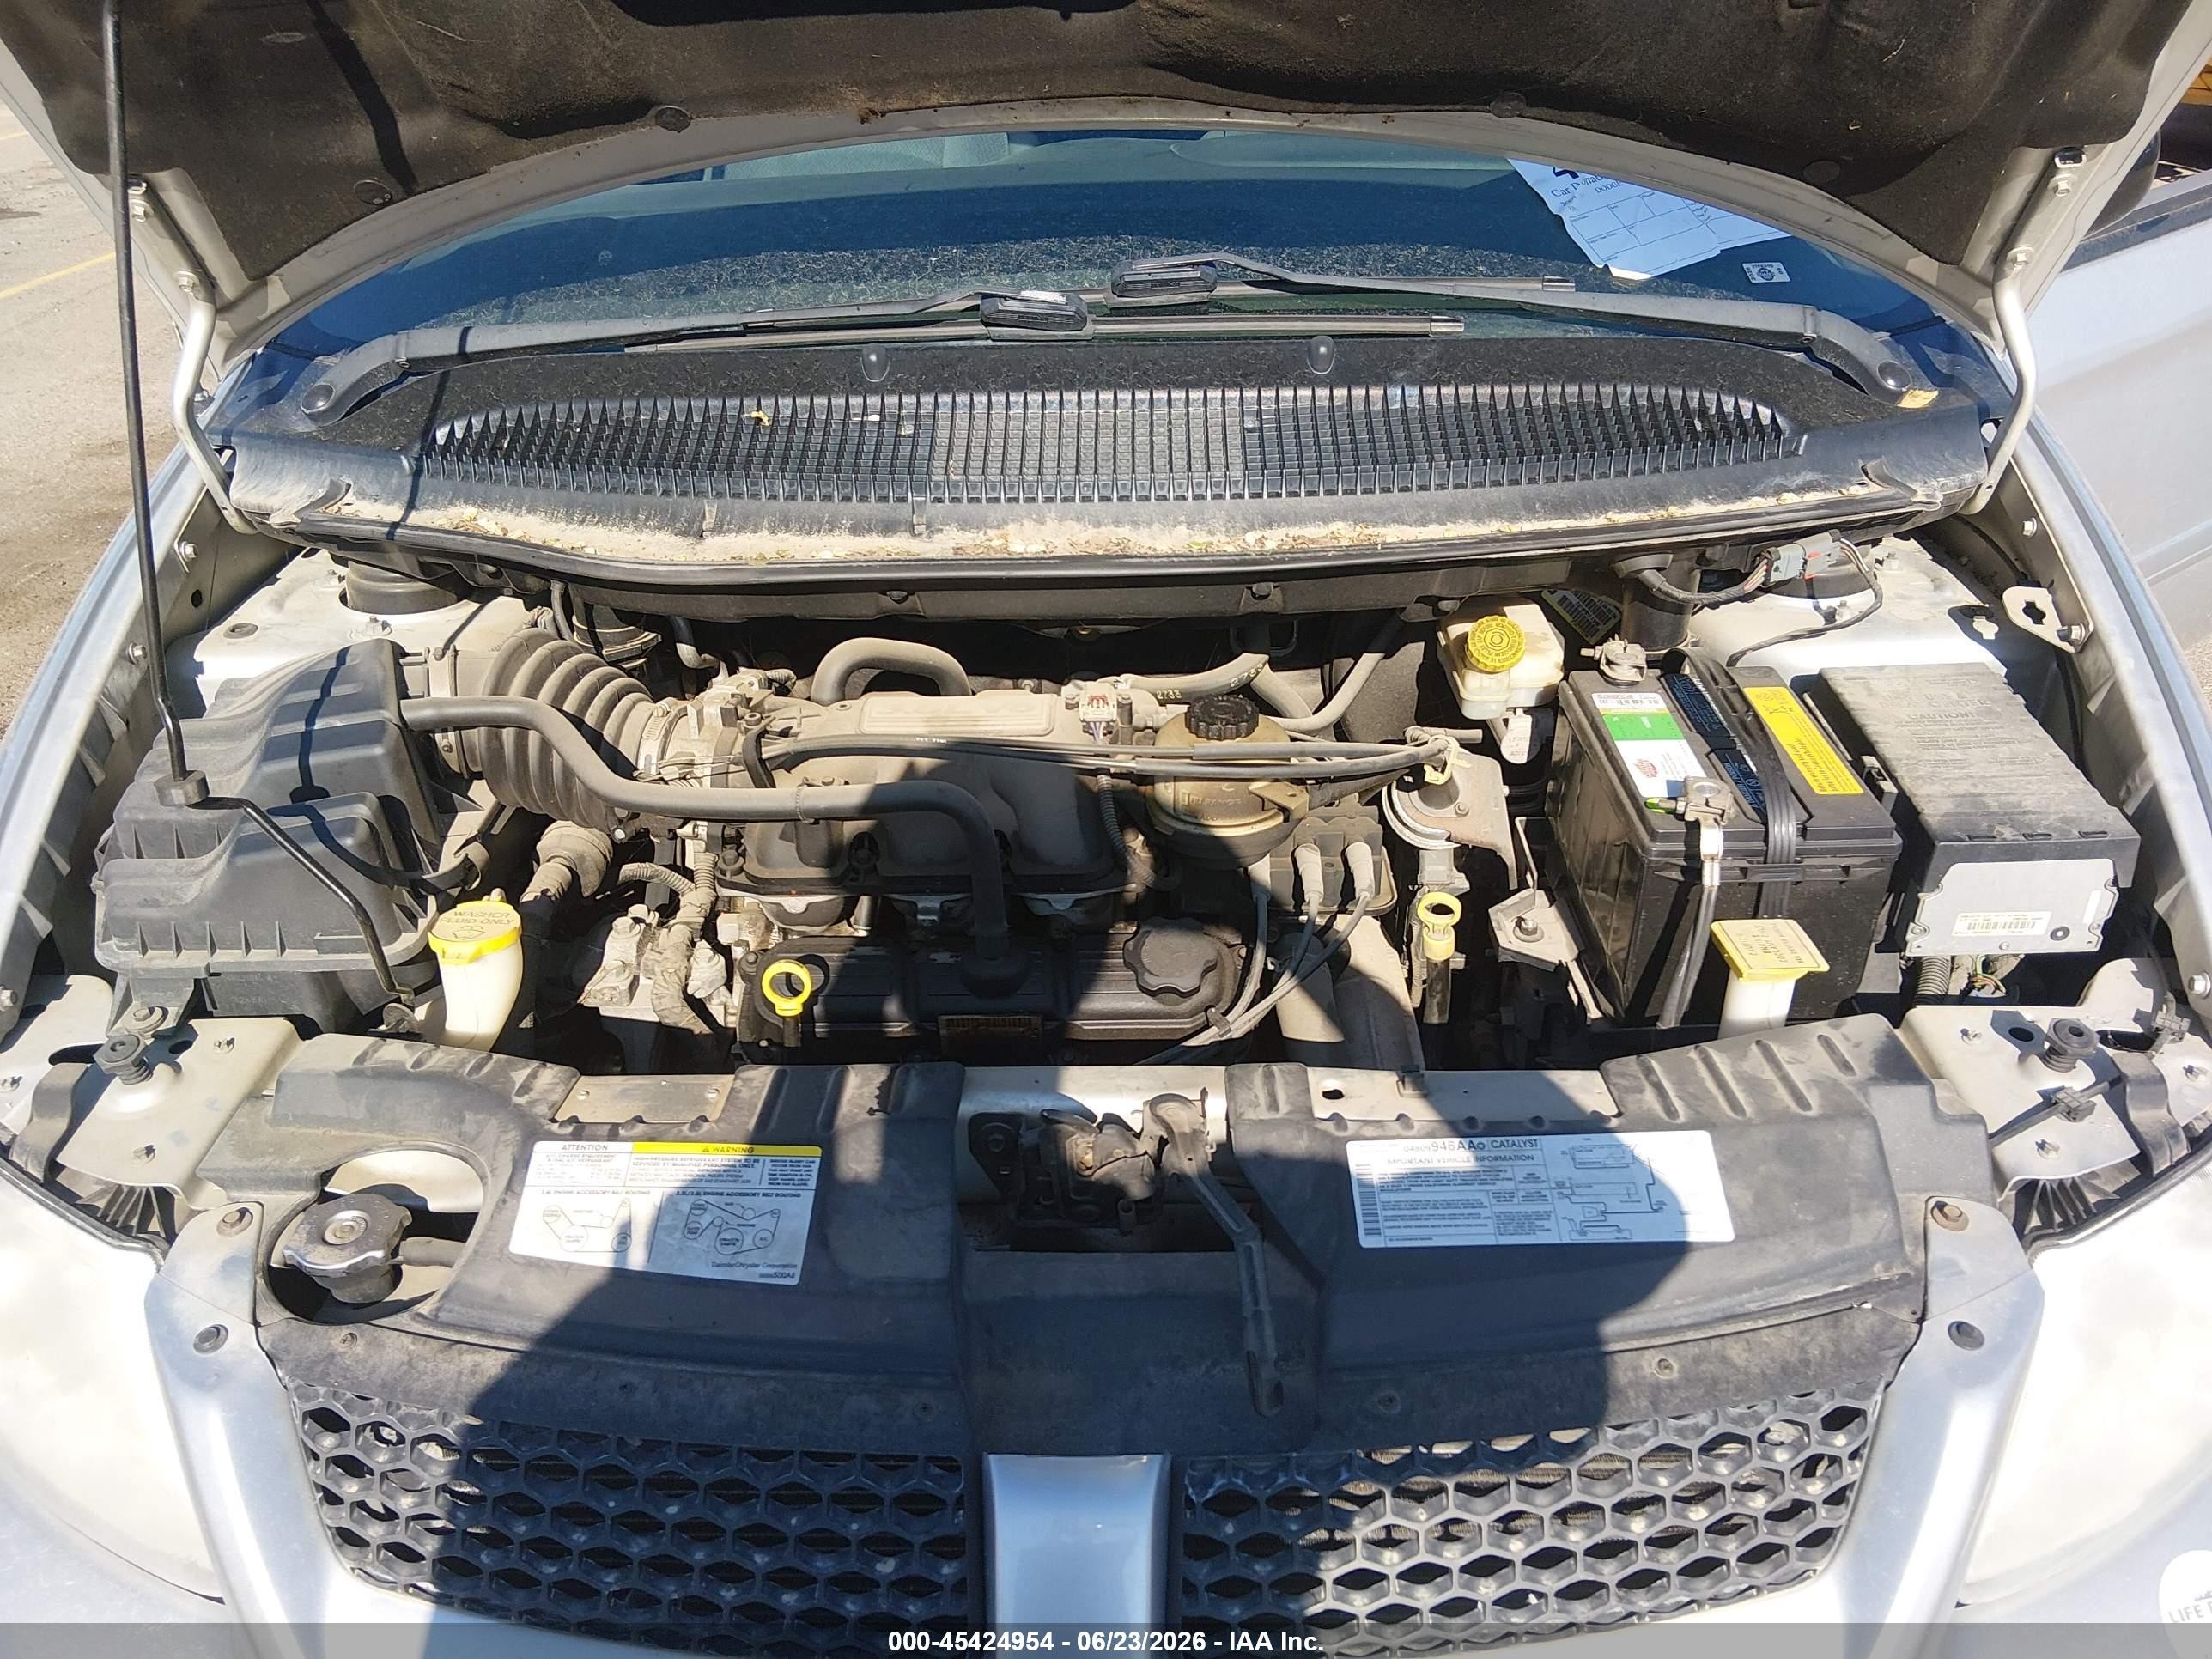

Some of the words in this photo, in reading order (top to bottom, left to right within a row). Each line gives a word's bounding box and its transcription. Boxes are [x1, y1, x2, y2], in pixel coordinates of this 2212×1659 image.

[1550, 186, 1571, 198] Car
[1490, 1139, 1538, 1149] CATALYST
[1475, 1154, 1534, 1163] INFORMATION
[2167, 1604, 2204, 1623] LIFE
